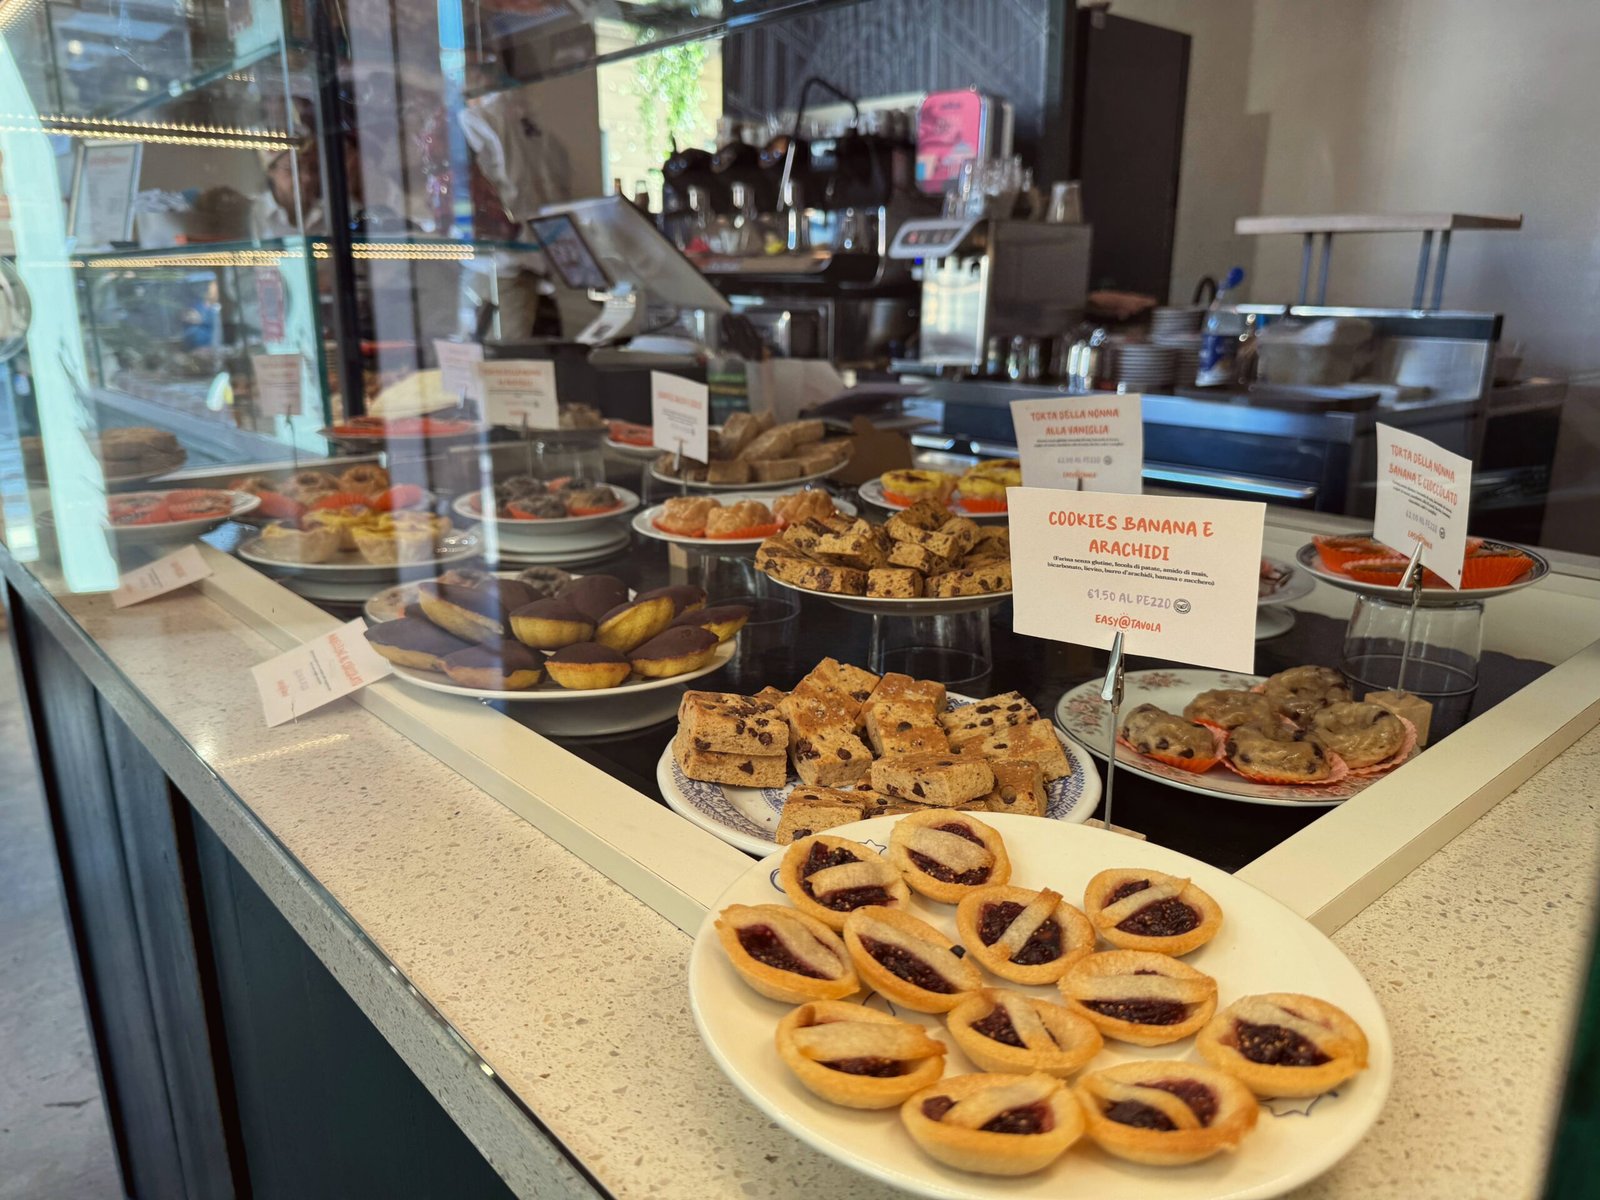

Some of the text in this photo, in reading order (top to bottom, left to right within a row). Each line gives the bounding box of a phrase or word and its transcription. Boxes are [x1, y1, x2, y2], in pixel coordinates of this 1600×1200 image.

[1031, 409, 1119, 421] TORTA DELLA NONNA
[1046, 425, 1108, 435] ALLA VANIGLIA
[1391, 444, 1455, 483] TORTA DELLA NONNA
[1388, 463, 1417, 483] BANANA
[1417, 473, 1423, 486] E
[1422, 477, 1458, 507] CIOCCOLATO
[1049, 511, 1214, 537] COOKIES BANANA E
[1089, 539, 1170, 561] ARACHIDI
[1047, 562, 1083, 571] bicarbonato,
[1083, 565, 1104, 573] lievito,
[1155, 574, 1178, 582] banana
[1184, 578, 1215, 586] zucchero)
[1091, 559, 1114, 567] glutine,
[1114, 561, 1133, 569] fecola
[1140, 565, 1162, 573] patate,
[1191, 570, 1209, 578] mais,
[1118, 592, 1133, 604] AL
[1136, 594, 1171, 609] PEZZO
[1095, 613, 1162, 633] EASY@TAVOLA
